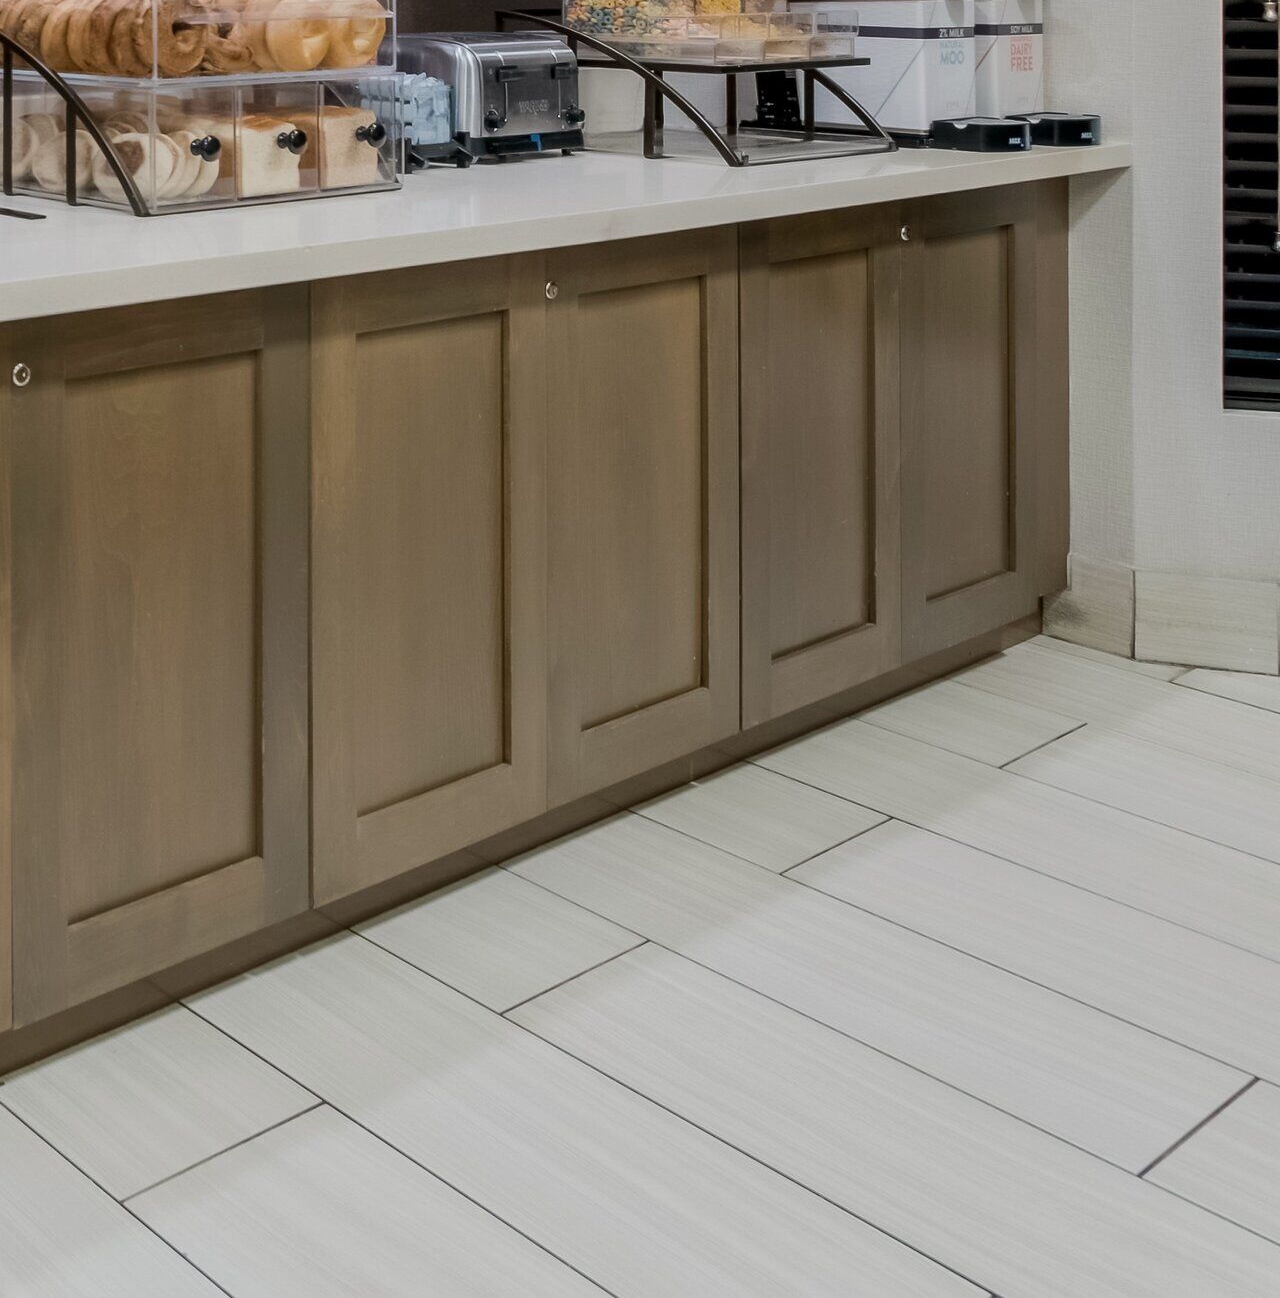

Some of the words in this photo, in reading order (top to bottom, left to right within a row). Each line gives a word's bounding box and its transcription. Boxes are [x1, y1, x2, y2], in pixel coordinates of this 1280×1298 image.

[948, 28, 965, 38] MILK
[1010, 43, 1033, 56] DAIRY
[940, 50, 965, 65] MOO
[1010, 56, 1033, 73] FREE
